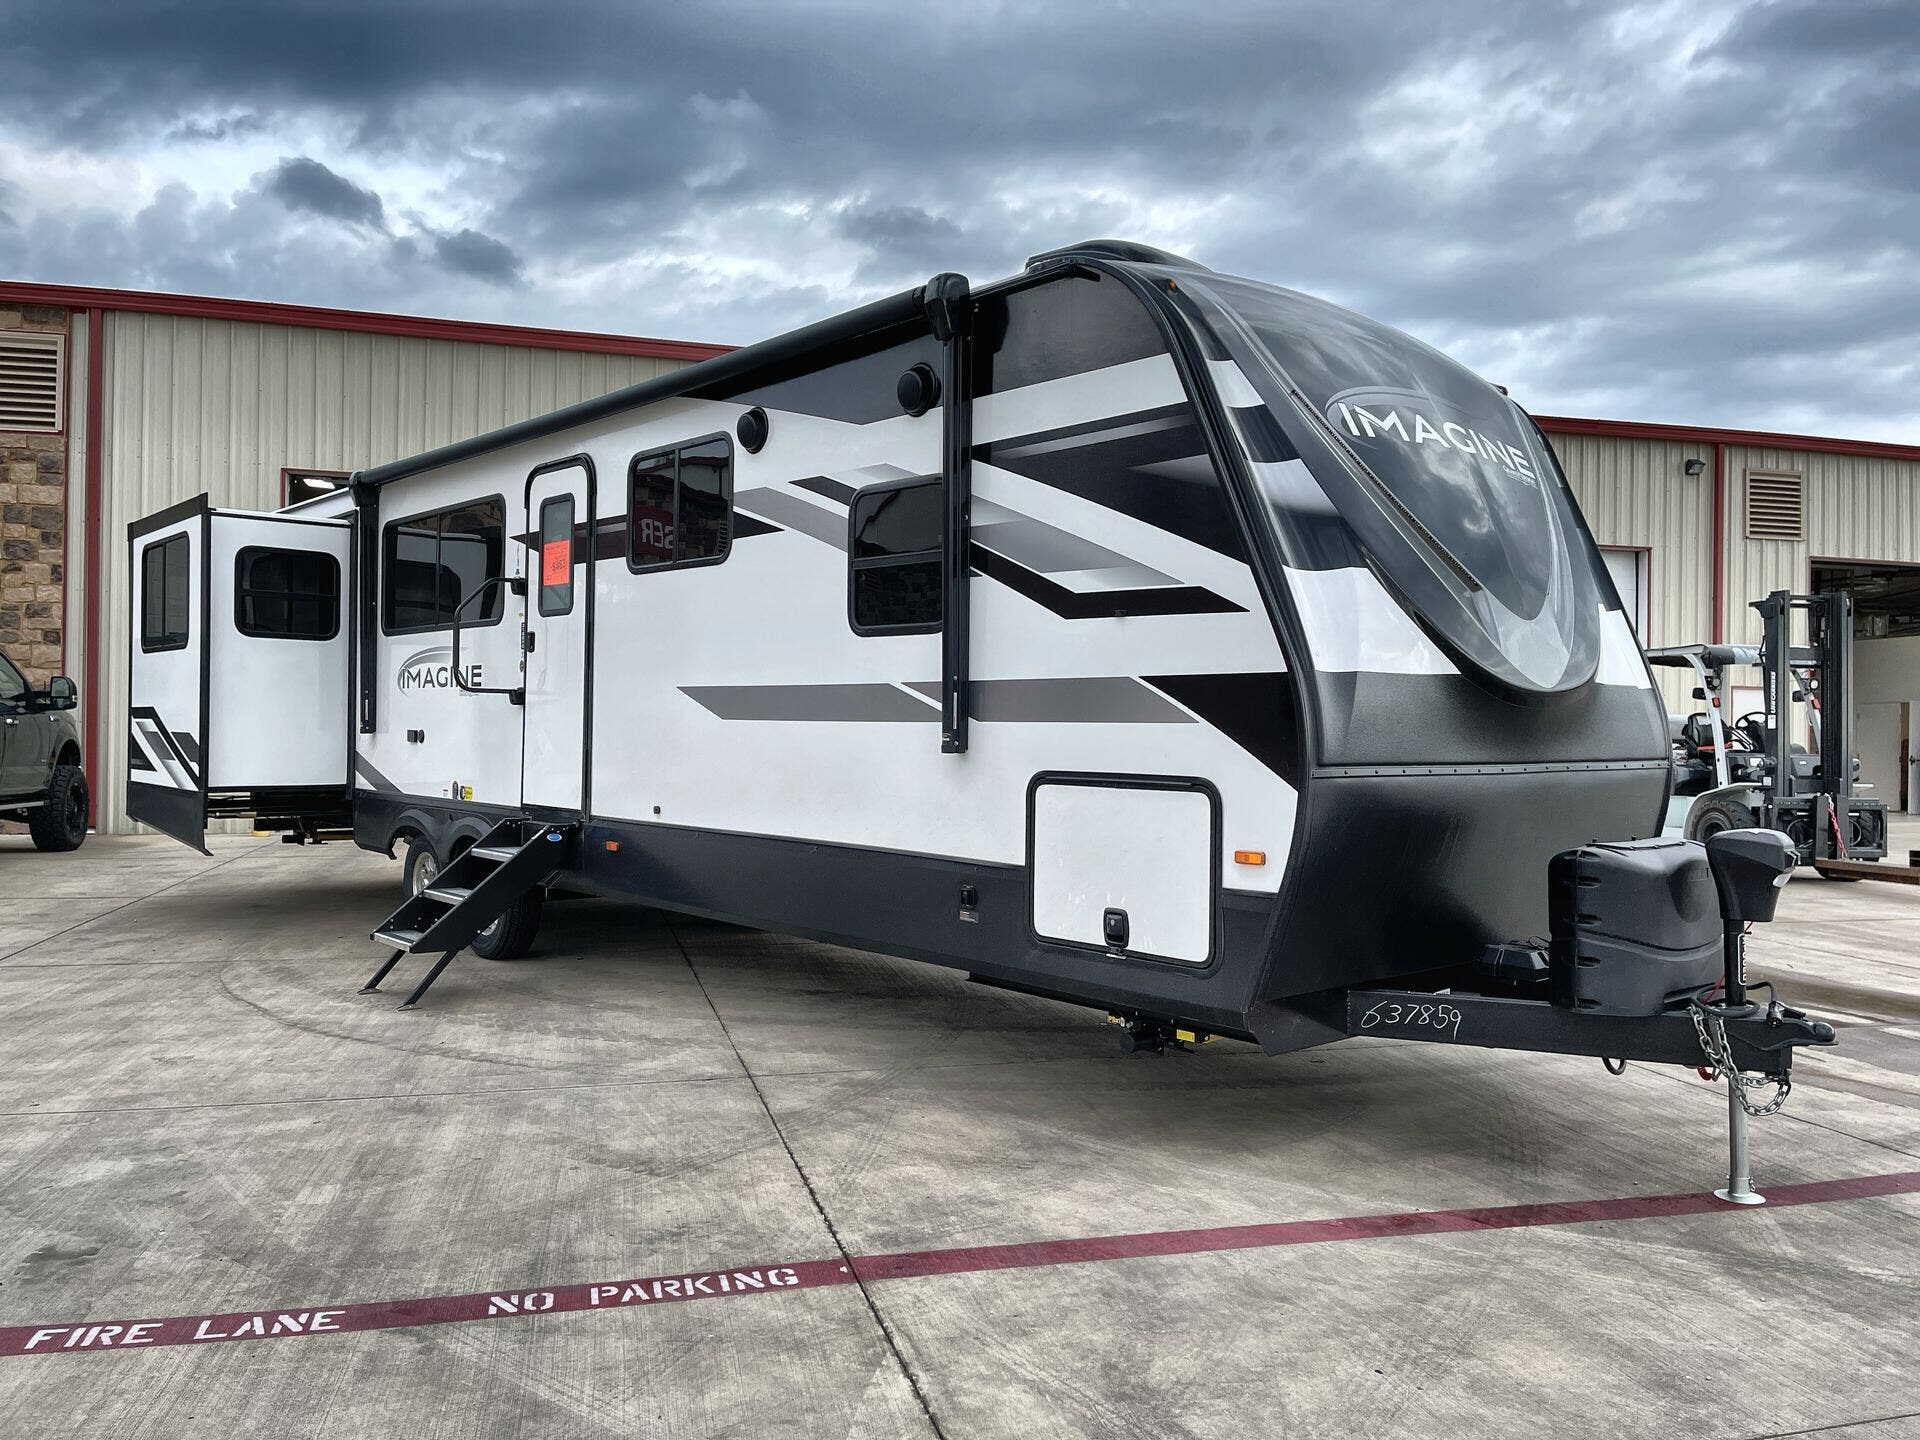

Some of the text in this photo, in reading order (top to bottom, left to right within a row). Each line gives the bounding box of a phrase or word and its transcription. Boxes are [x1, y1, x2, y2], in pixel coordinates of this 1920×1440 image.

[1338, 402, 1535, 479] IMAGINE
[402, 664, 482, 689] IMAGINE
[1361, 1000, 1462, 1040] 637859
[24, 1267, 799, 1350] FIRE LANE NO PARKING
